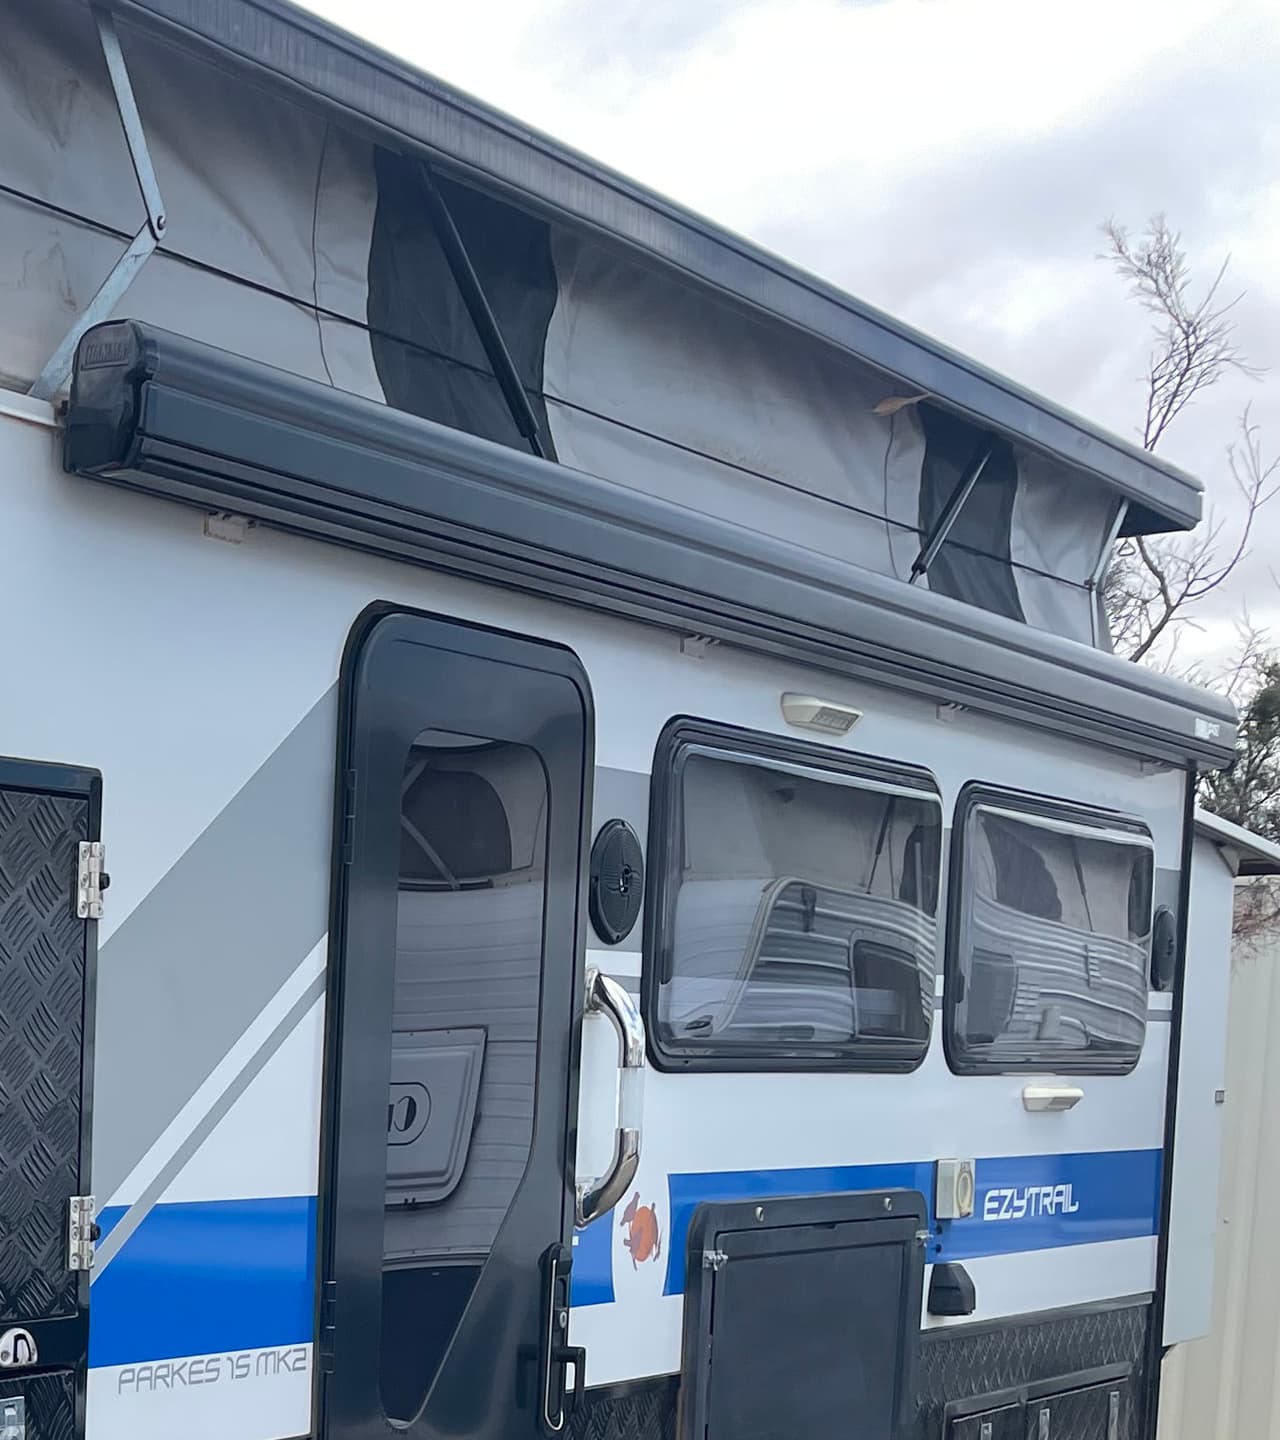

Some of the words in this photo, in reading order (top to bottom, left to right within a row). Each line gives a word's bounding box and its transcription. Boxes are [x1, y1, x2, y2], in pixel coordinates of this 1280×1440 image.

[983, 1183, 1079, 1221] EZYTRAIL
[118, 1357, 221, 1395] PARKES
[227, 1353, 251, 1380] 15
[256, 1347, 307, 1377] MK2
